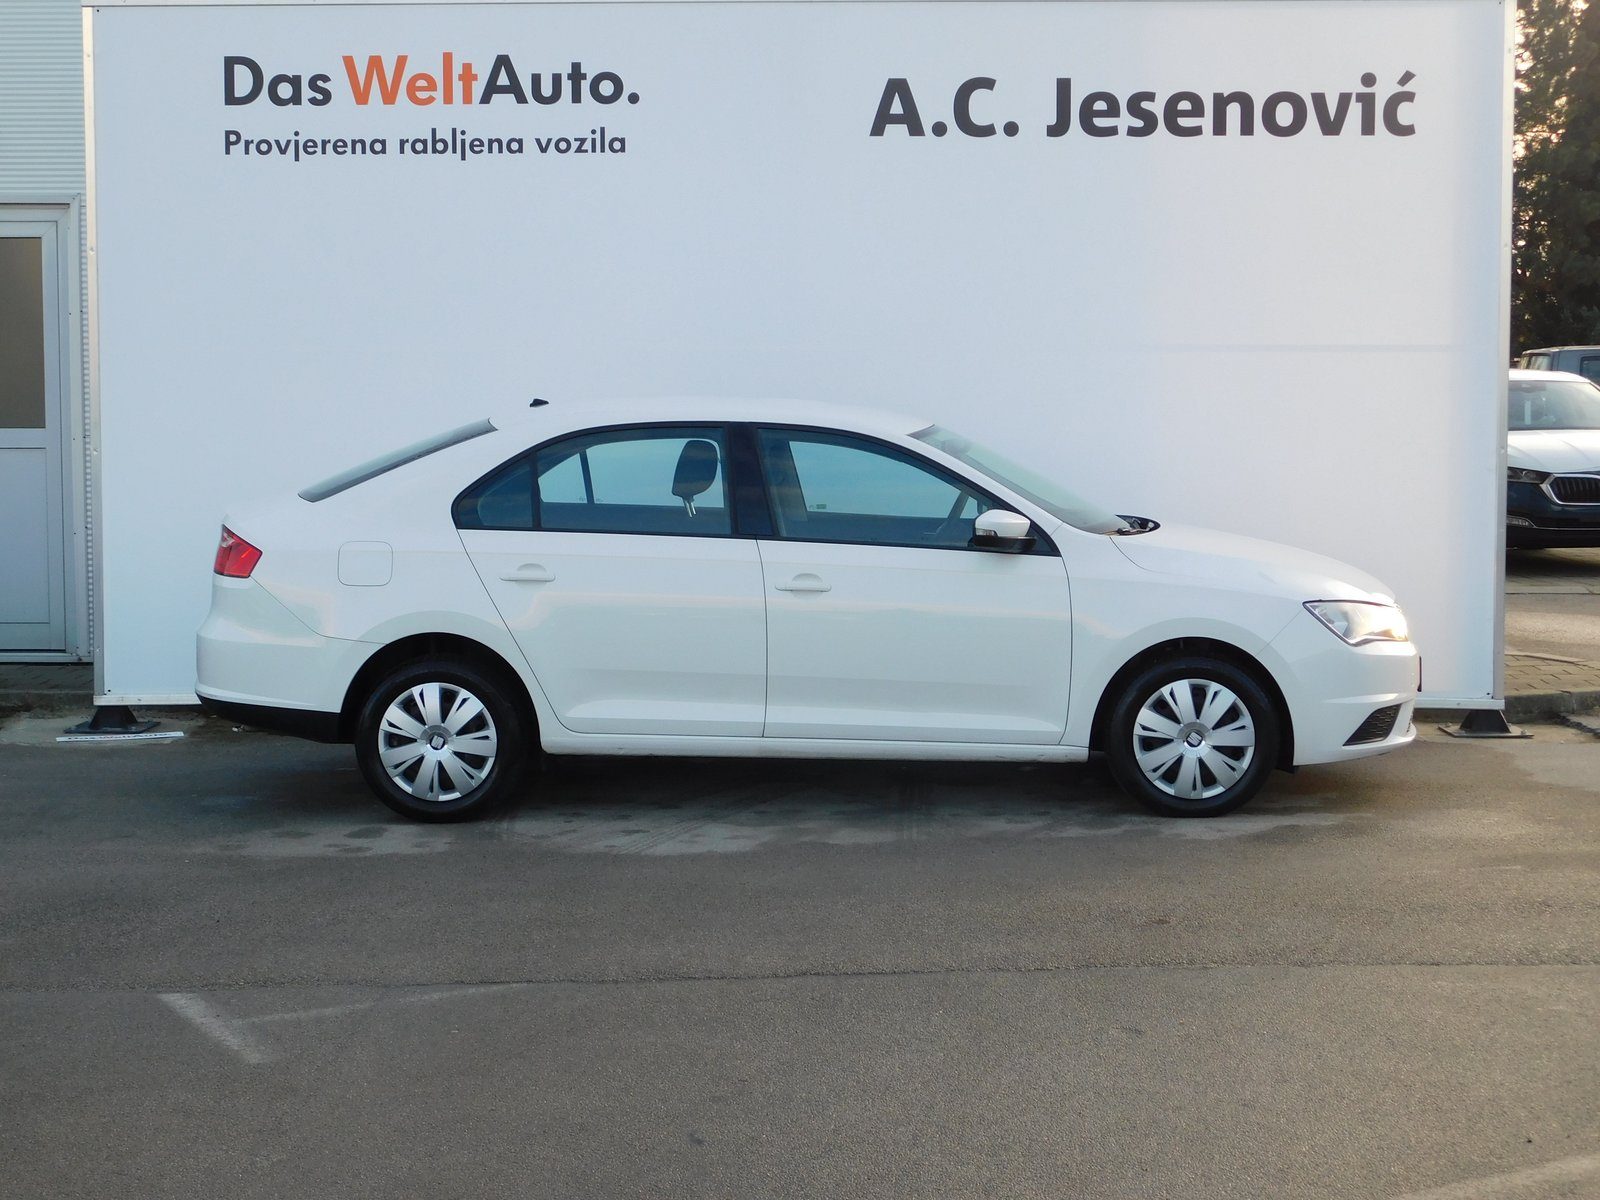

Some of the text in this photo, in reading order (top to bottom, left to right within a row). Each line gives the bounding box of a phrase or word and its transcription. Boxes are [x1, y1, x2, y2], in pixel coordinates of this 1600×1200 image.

[224, 51, 640, 107] Das WeltAuto.
[869, 70, 1417, 138] A.C. Jesenović
[224, 127, 626, 163] Provjerena rabljena vozila
